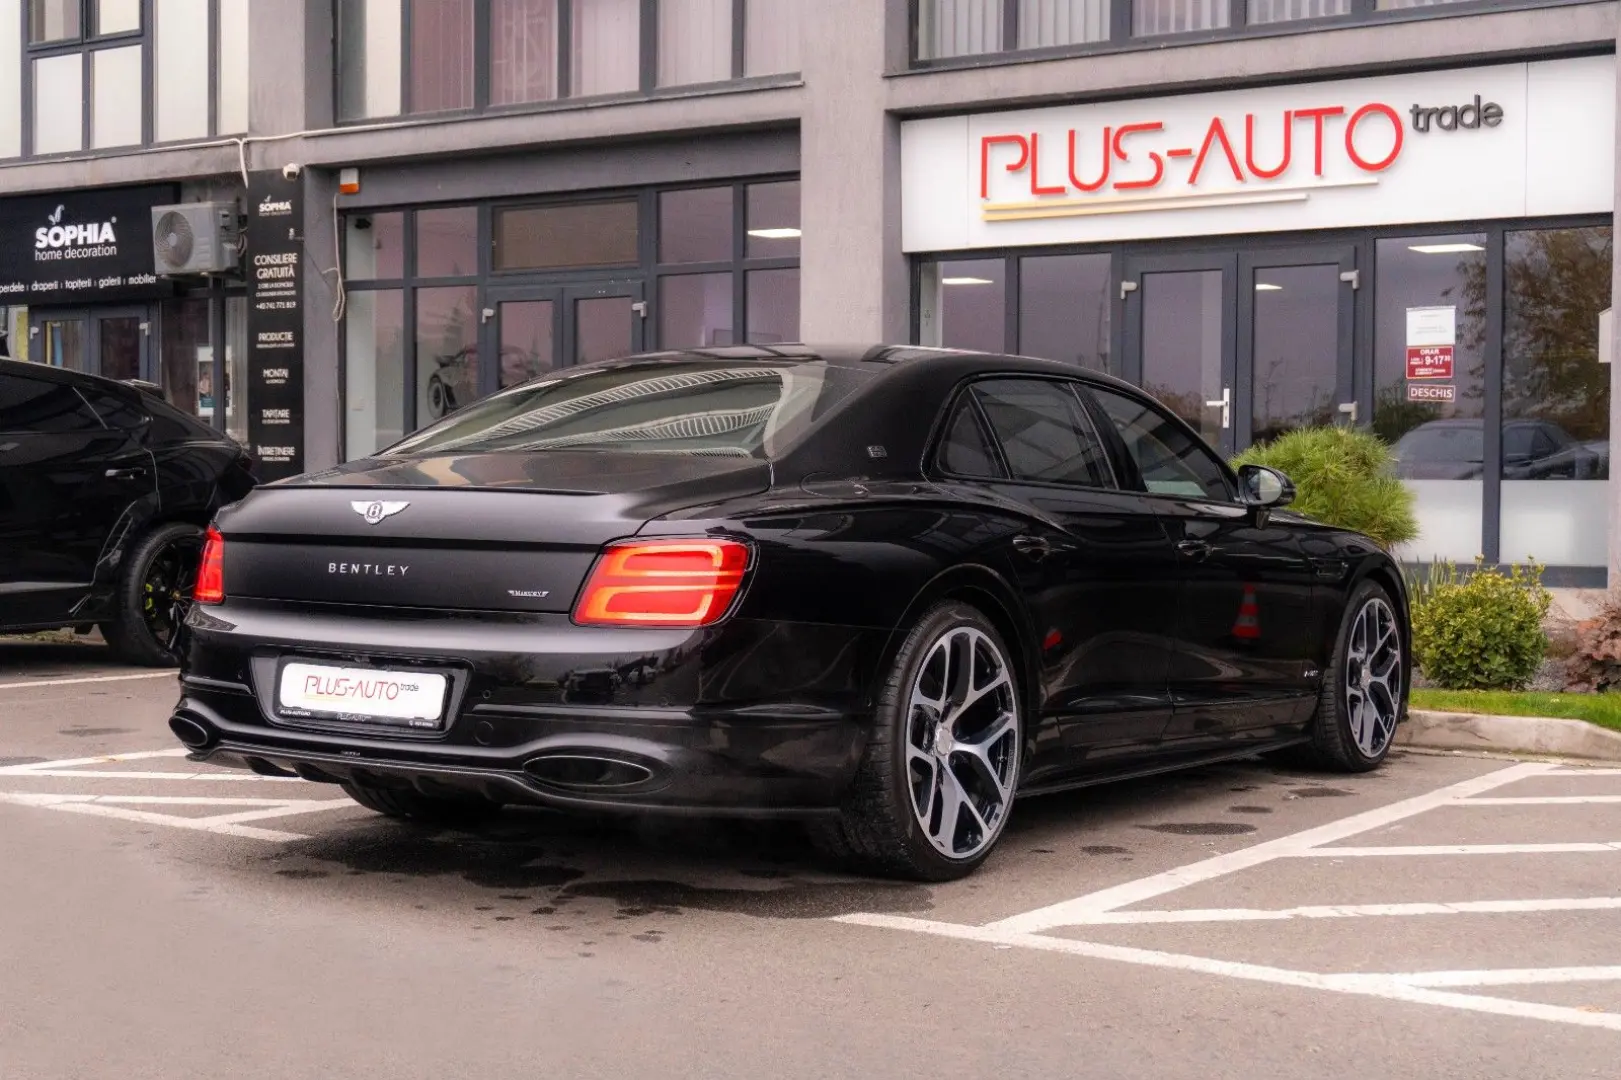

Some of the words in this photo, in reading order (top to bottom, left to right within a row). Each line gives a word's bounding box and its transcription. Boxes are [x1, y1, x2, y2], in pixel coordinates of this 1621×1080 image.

[981, 103, 1404, 199] PLUS-AUTO
[1410, 95, 1503, 132] trade
[258, 201, 292, 212] SOPHIA
[35, 222, 116, 248] SOPHIA
[35, 249, 62, 261] home
[64, 245, 117, 260] decoration
[254, 253, 298, 266] CONSILIERE
[128, 273, 157, 285] mobilier
[1410, 387, 1453, 399] DESCHIS
[328, 562, 409, 577] BENTLEY
[305, 675, 399, 700] PLUS-AUTO
[400, 683, 419, 692] trade
